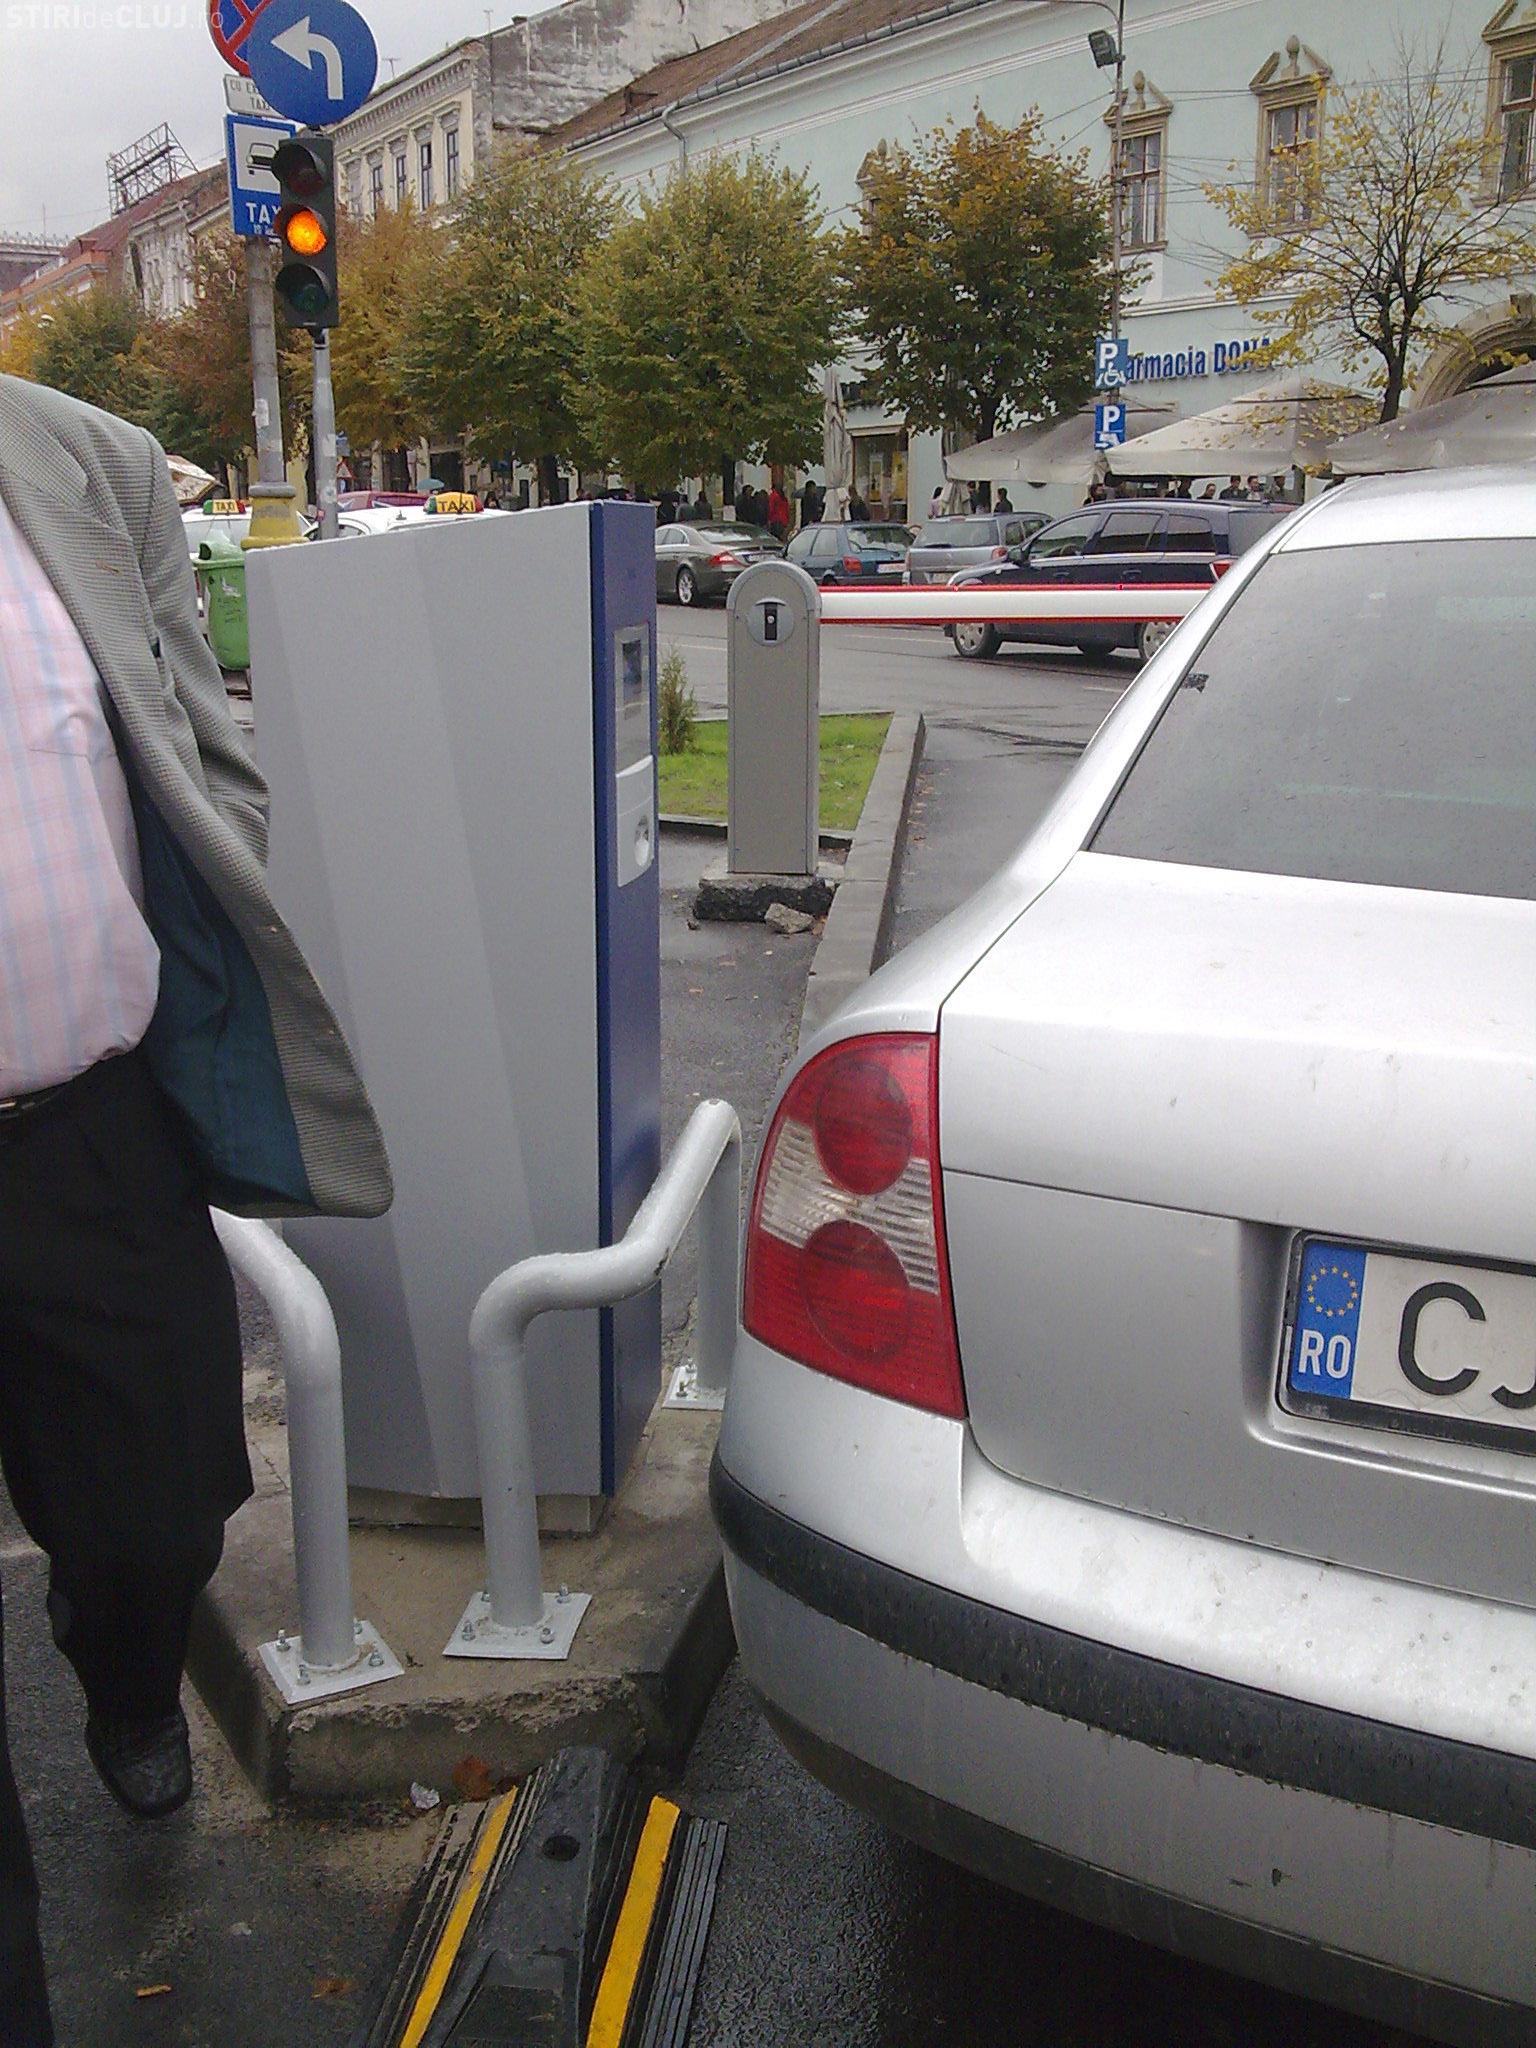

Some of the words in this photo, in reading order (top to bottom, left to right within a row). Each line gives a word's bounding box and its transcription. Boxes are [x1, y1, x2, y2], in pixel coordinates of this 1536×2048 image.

[1099, 342, 1119, 369] P
[1127, 345, 1206, 380] armacia
[1103, 405, 1121, 432] P
[437, 500, 475, 513] TAXI
[1298, 1328, 1352, 1379] RO
